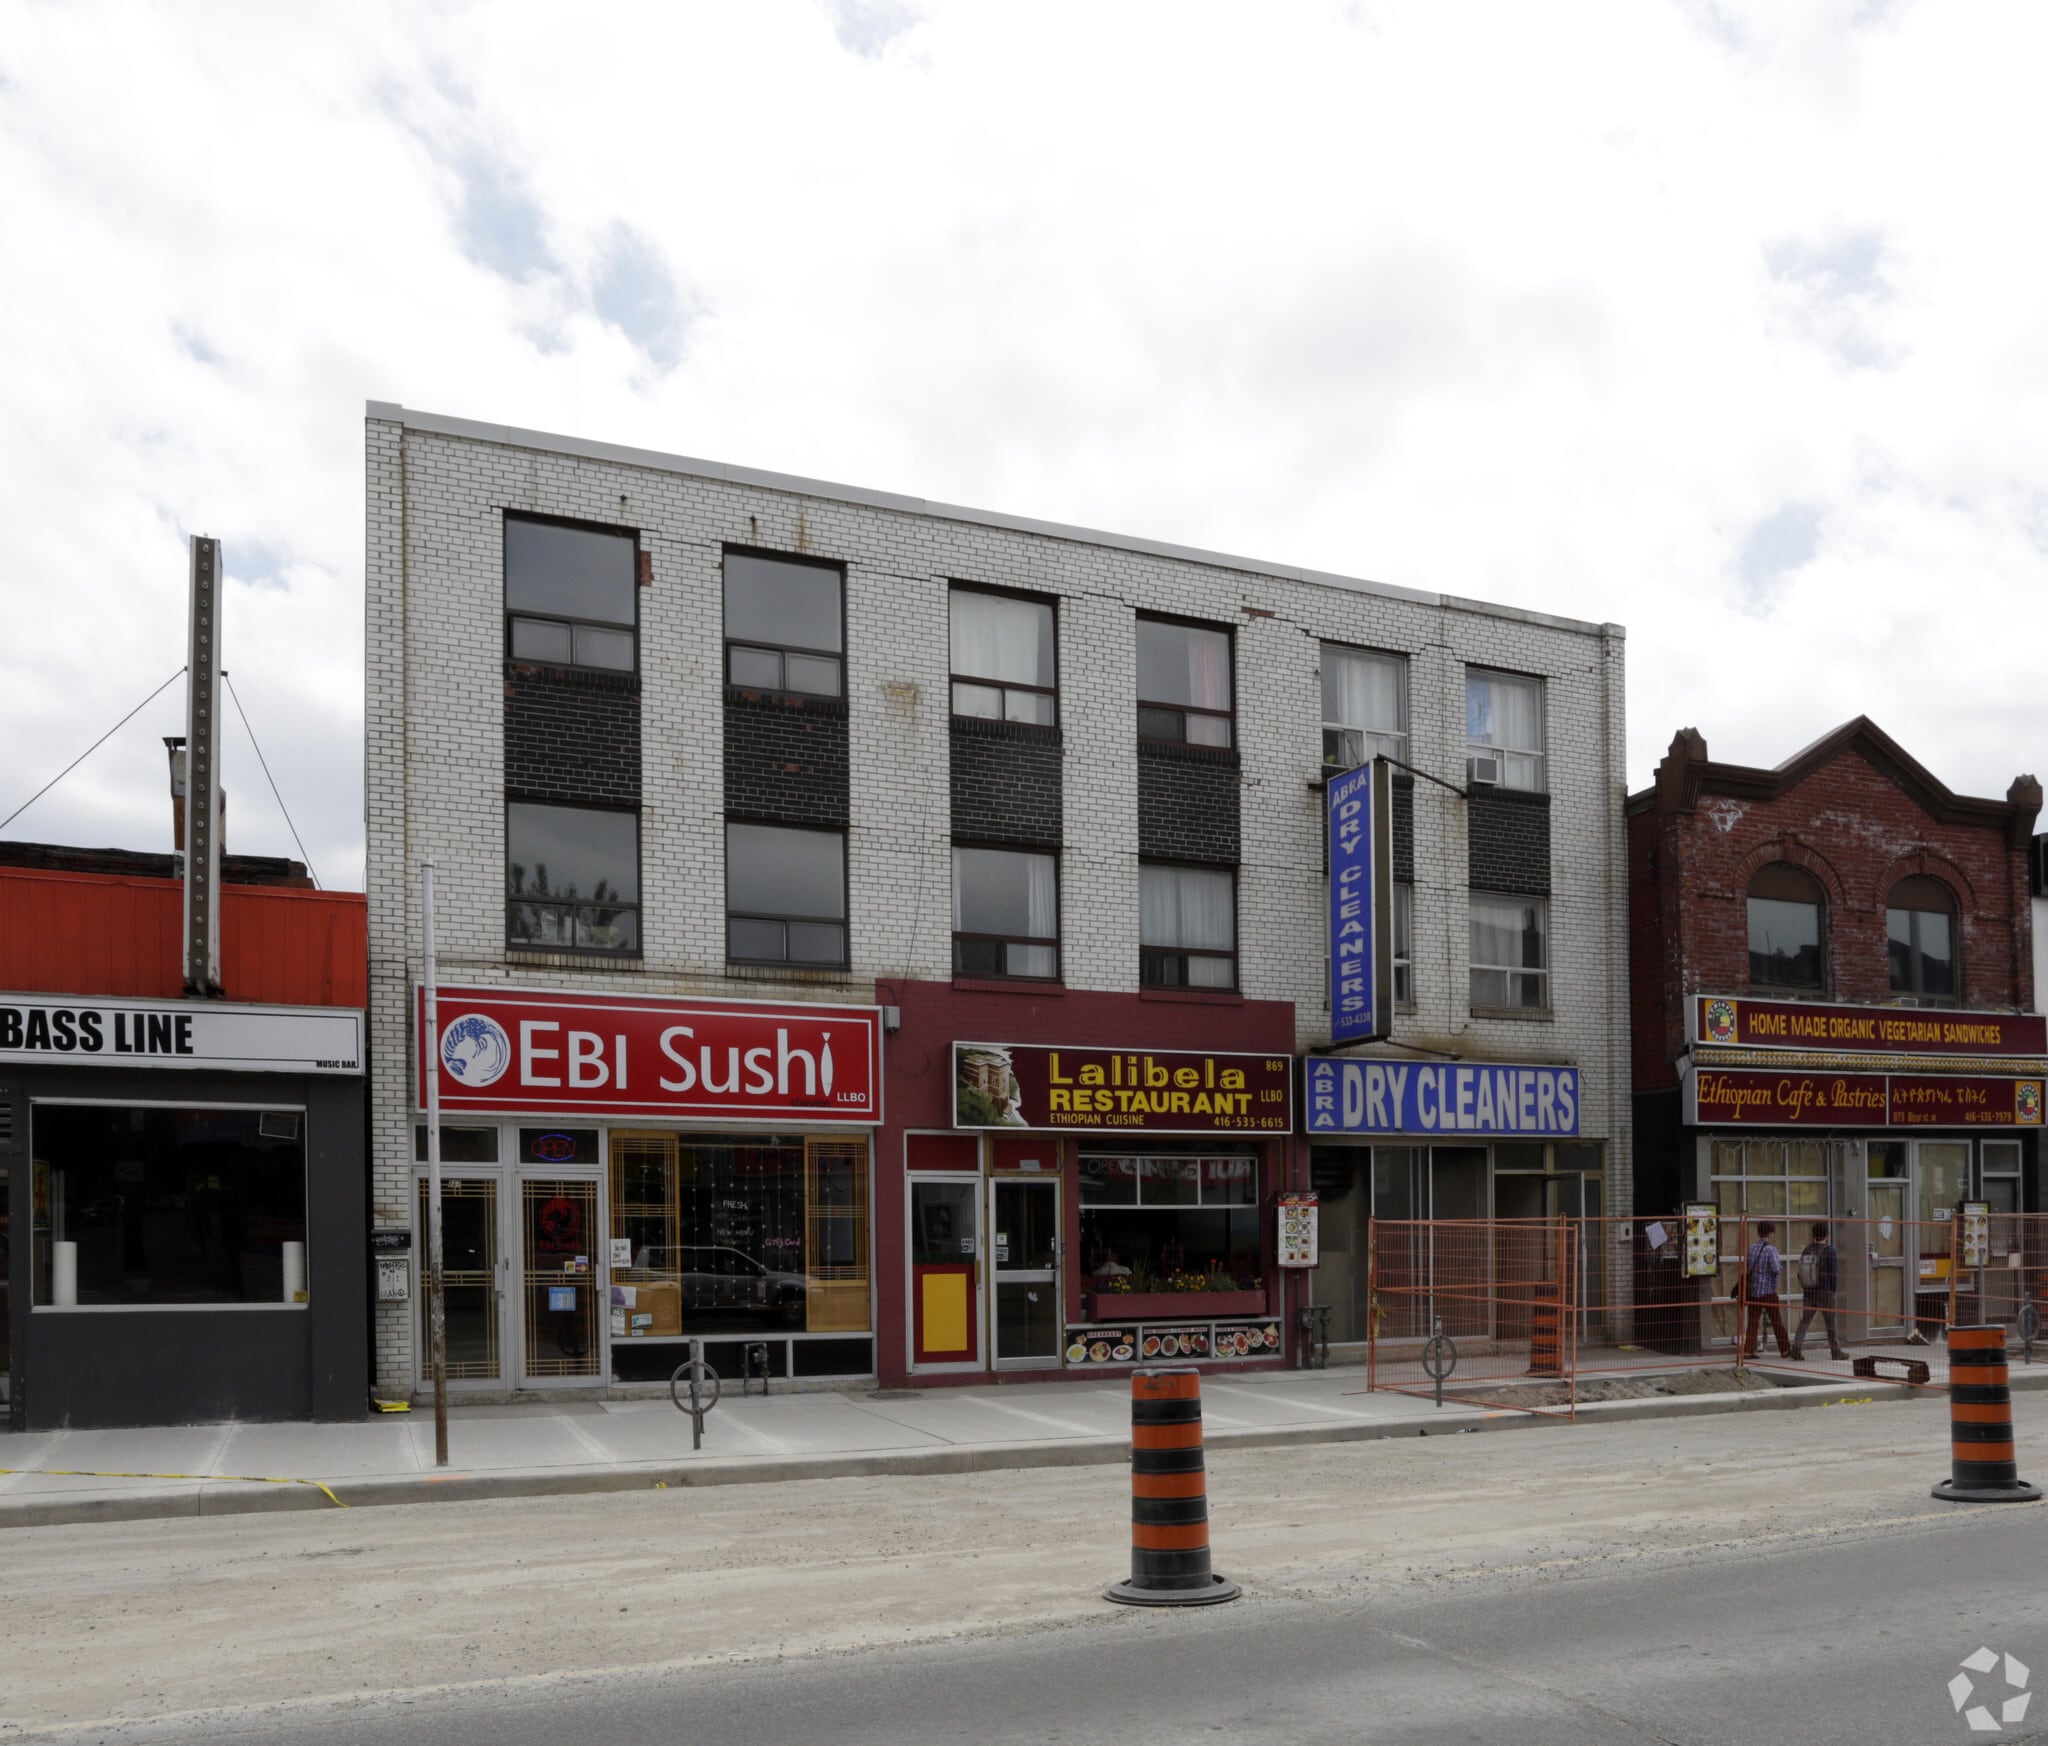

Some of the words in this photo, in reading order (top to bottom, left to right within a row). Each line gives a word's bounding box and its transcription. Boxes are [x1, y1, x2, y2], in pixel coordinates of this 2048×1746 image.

[1332, 771, 1368, 811] ABRA
[1340, 800, 1363, 854] DRY
[1339, 865, 1365, 1012] CLEANERS
[0, 1008, 104, 1052] BASS
[115, 1013, 194, 1055] LINE
[1750, 1012, 1787, 1036] HOME
[1791, 1015, 1828, 1037] MADE
[1830, 1017, 1876, 1040] ORGANIC
[1879, 1020, 1941, 1042] VEGETARIAN
[1944, 1023, 2001, 1045] SANDWICHES
[316, 1060, 340, 1069] MUSIC
[519, 1020, 627, 1090] EBI
[659, 1026, 834, 1098] Sushi
[1050, 1053, 1245, 1090] Lalibela
[1265, 1060, 1283, 1072] 869
[836, 1092, 866, 1102] LLBO
[1050, 1089, 1252, 1115] RESTAURANT
[1260, 1089, 1283, 1102] LLBO
[1313, 1062, 1336, 1127] ABRA
[1342, 1063, 1408, 1129] DRY
[1417, 1065, 1575, 1132] CLEANERS
[1697, 1074, 1773, 1120] Ethiopian
[1777, 1079, 1814, 1120] Café
[1816, 1091, 1828, 1107] &
[1832, 1079, 1887, 1108] Pastries
[1050, 1113, 1101, 1125] ETHIOPIAN
[1106, 1114, 1145, 1126] CUISINE
[1214, 1116, 1284, 1128] 416-535-6615
[531, 1138, 576, 1158] OPEN
